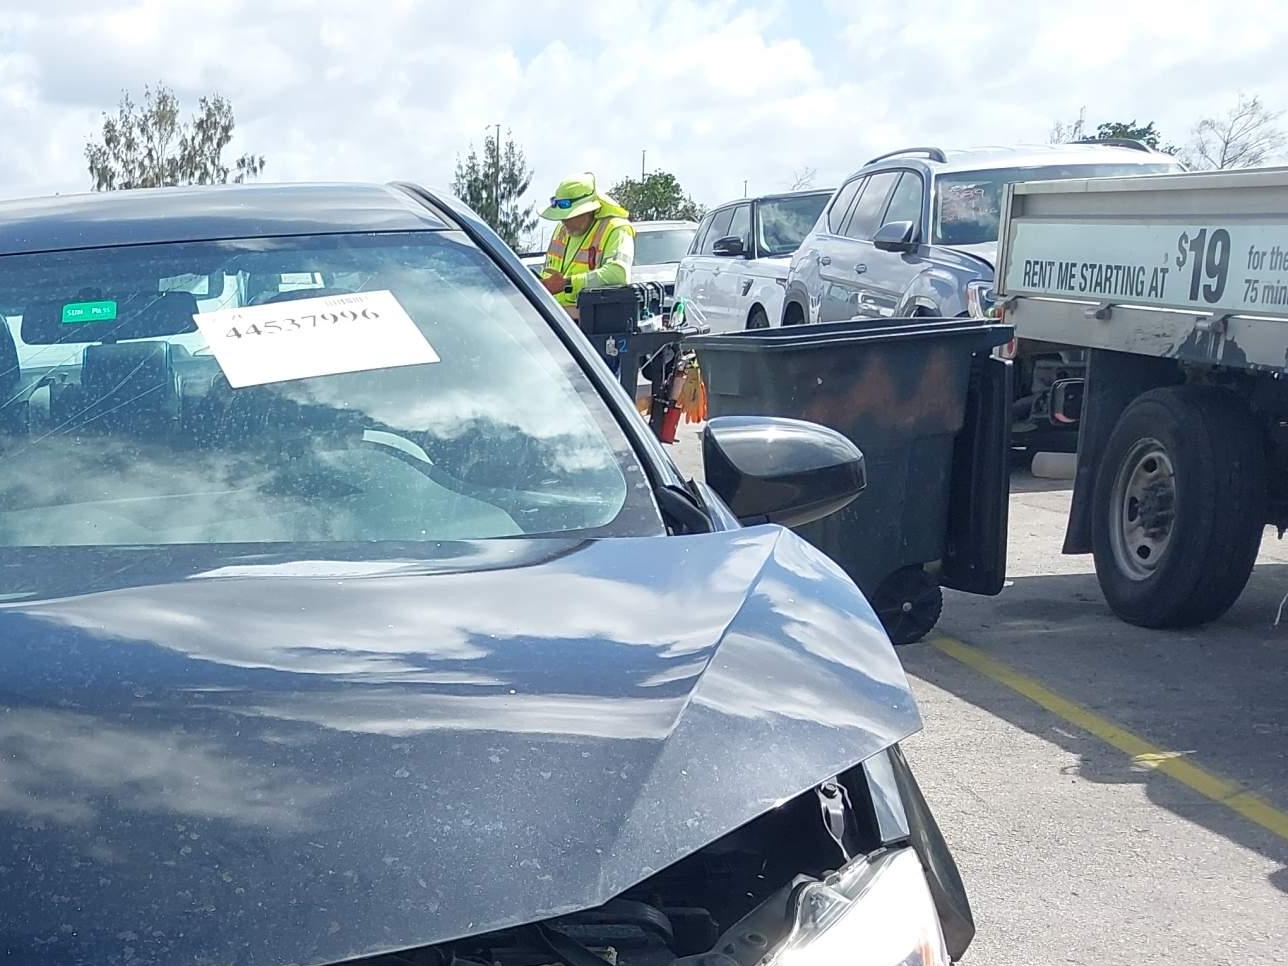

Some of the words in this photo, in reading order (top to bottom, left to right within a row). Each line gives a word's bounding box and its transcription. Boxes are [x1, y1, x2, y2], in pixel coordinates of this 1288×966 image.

[1023, 260, 1055, 289] RENT
[1056, 262, 1077, 291] ME
[1079, 263, 1145, 297] STARTING
[1148, 267, 1169, 299] AT
[1176, 228, 1231, 304] $19
[1247, 245, 1267, 271] for
[1243, 279, 1259, 304] 75
[225, 307, 381, 340] 44537996
